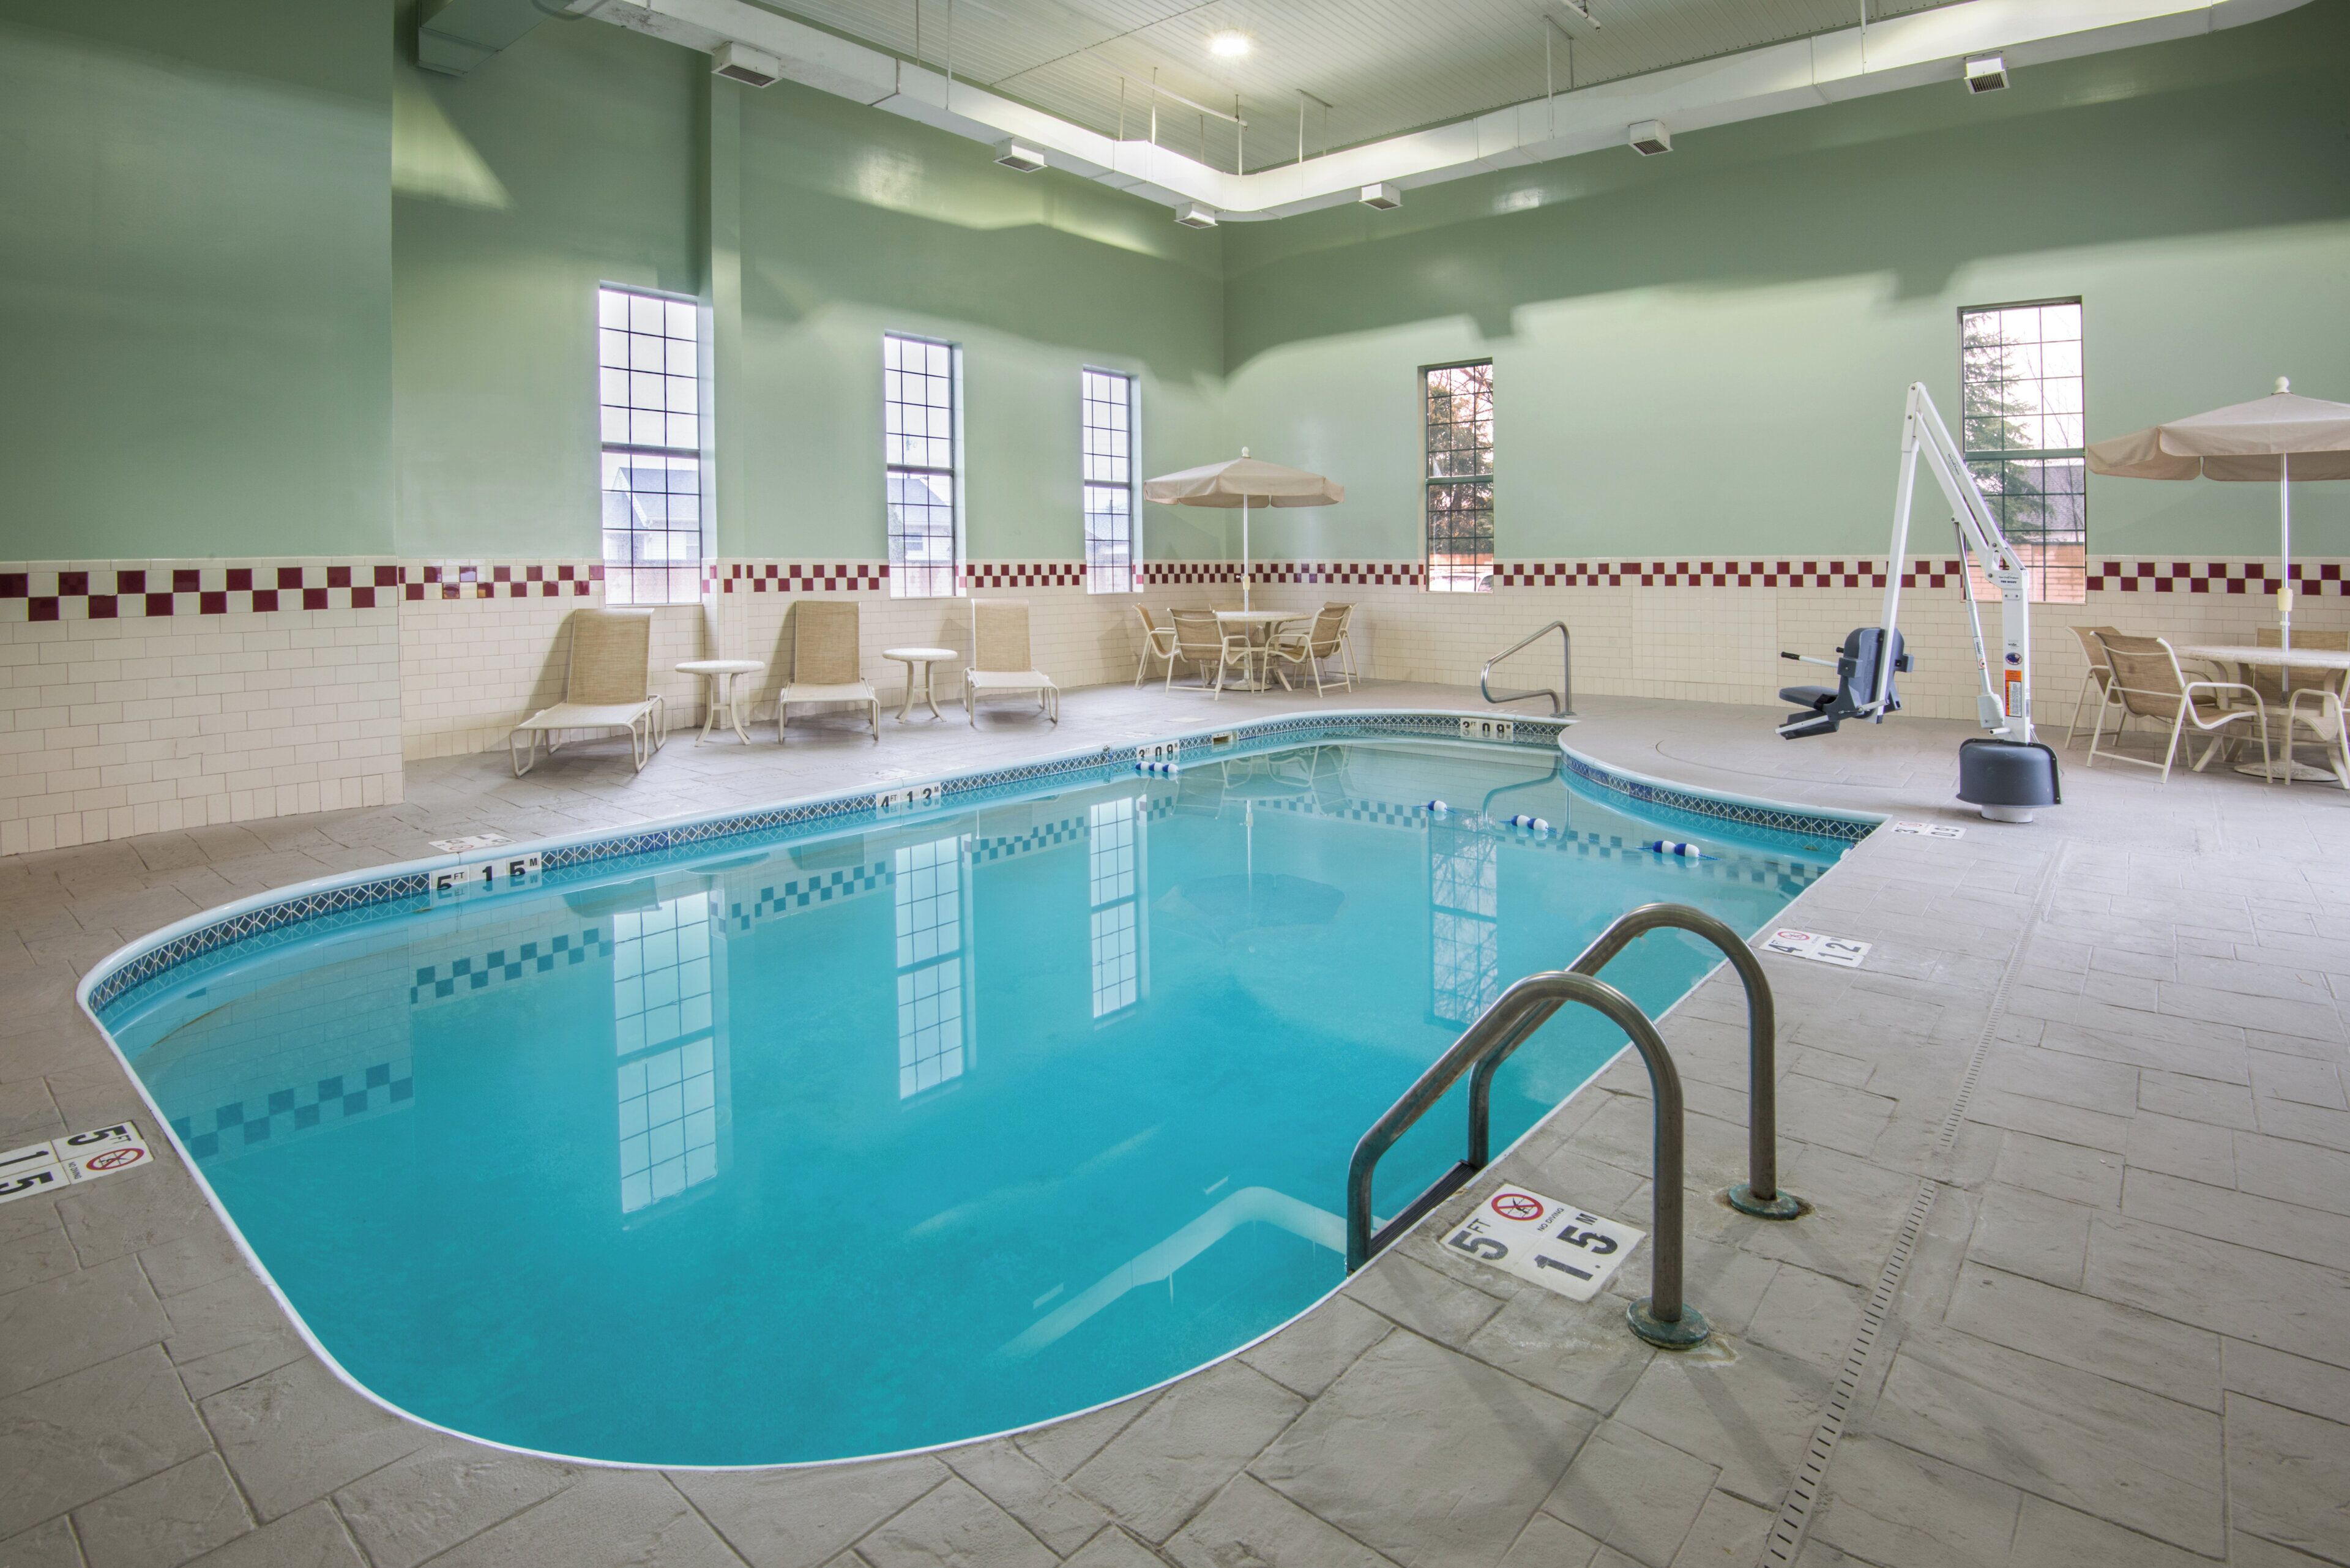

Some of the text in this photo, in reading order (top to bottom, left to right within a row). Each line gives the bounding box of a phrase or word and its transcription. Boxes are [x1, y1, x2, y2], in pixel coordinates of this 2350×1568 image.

[454, 872, 465, 880] FT
[530, 858, 537, 867] M
[1769, 944, 1803, 953] 4
[67, 1125, 132, 1146] 5 FT
[70, 1167, 82, 1179] DIVING
[1537, 1207, 1564, 1232] NO DIVING
[1576, 1213, 1598, 1226] M
[1448, 1218, 1509, 1261] 5 FT
